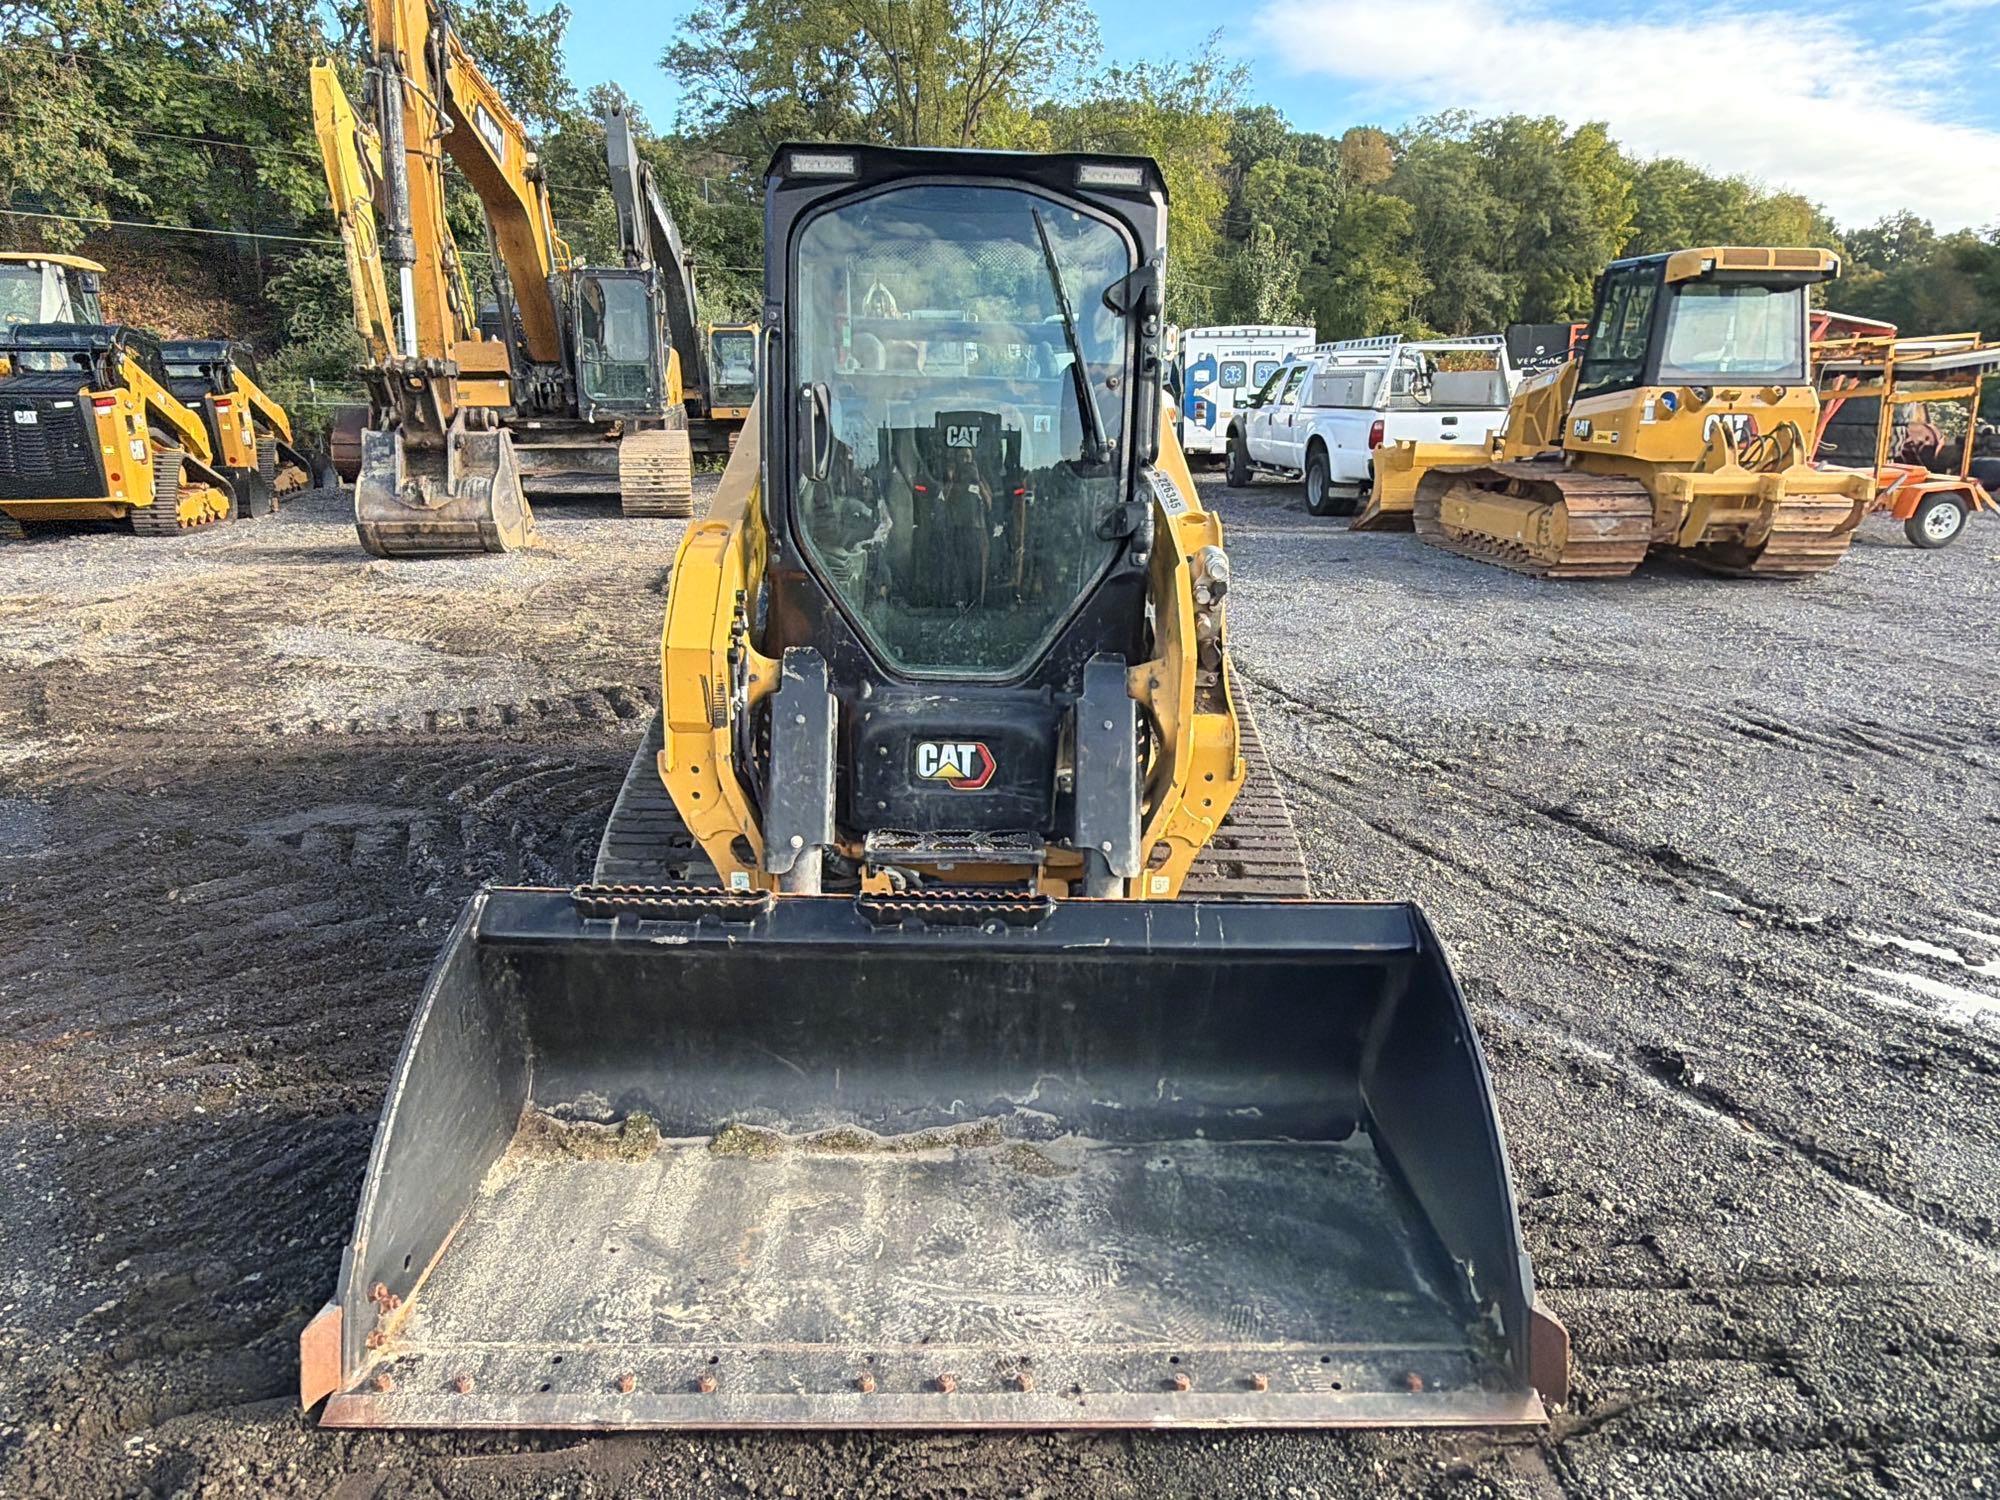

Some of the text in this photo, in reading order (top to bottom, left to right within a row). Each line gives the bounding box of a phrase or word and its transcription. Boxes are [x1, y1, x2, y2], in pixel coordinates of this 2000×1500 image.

[14, 410, 38, 424] CAT
[1573, 419, 1591, 437] CAT
[946, 425, 981, 448] CAT
[1158, 478, 1182, 509] 226345
[918, 743, 976, 778] CAT
